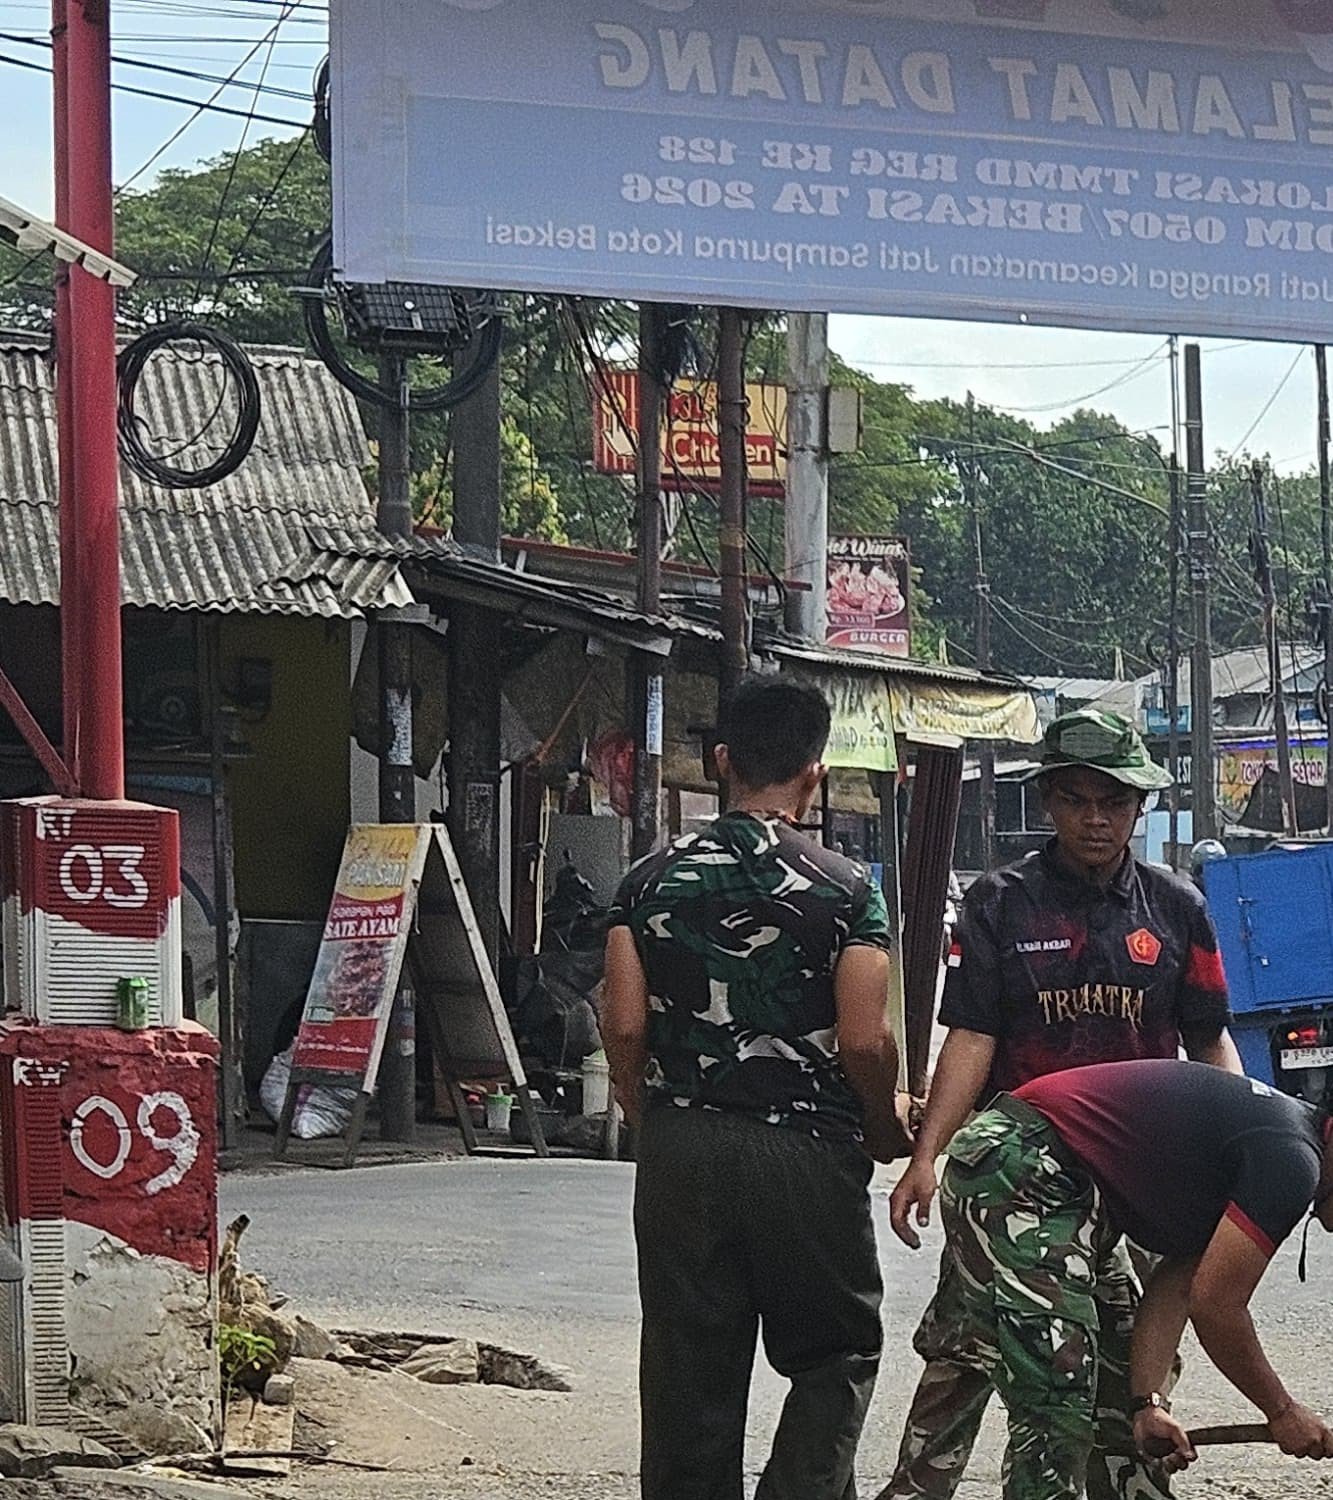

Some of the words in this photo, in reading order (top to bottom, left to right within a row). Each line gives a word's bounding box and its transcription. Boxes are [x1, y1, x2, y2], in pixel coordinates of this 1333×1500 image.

[671, 432, 771, 463] Chicen
[849, 631, 906, 643] BURGER
[36, 808, 77, 841] RT
[59, 844, 149, 908] 03
[322, 920, 359, 939] SATE
[356, 917, 401, 937] AYAM
[13, 1057, 70, 1086] RW
[69, 1090, 201, 1196] 09
